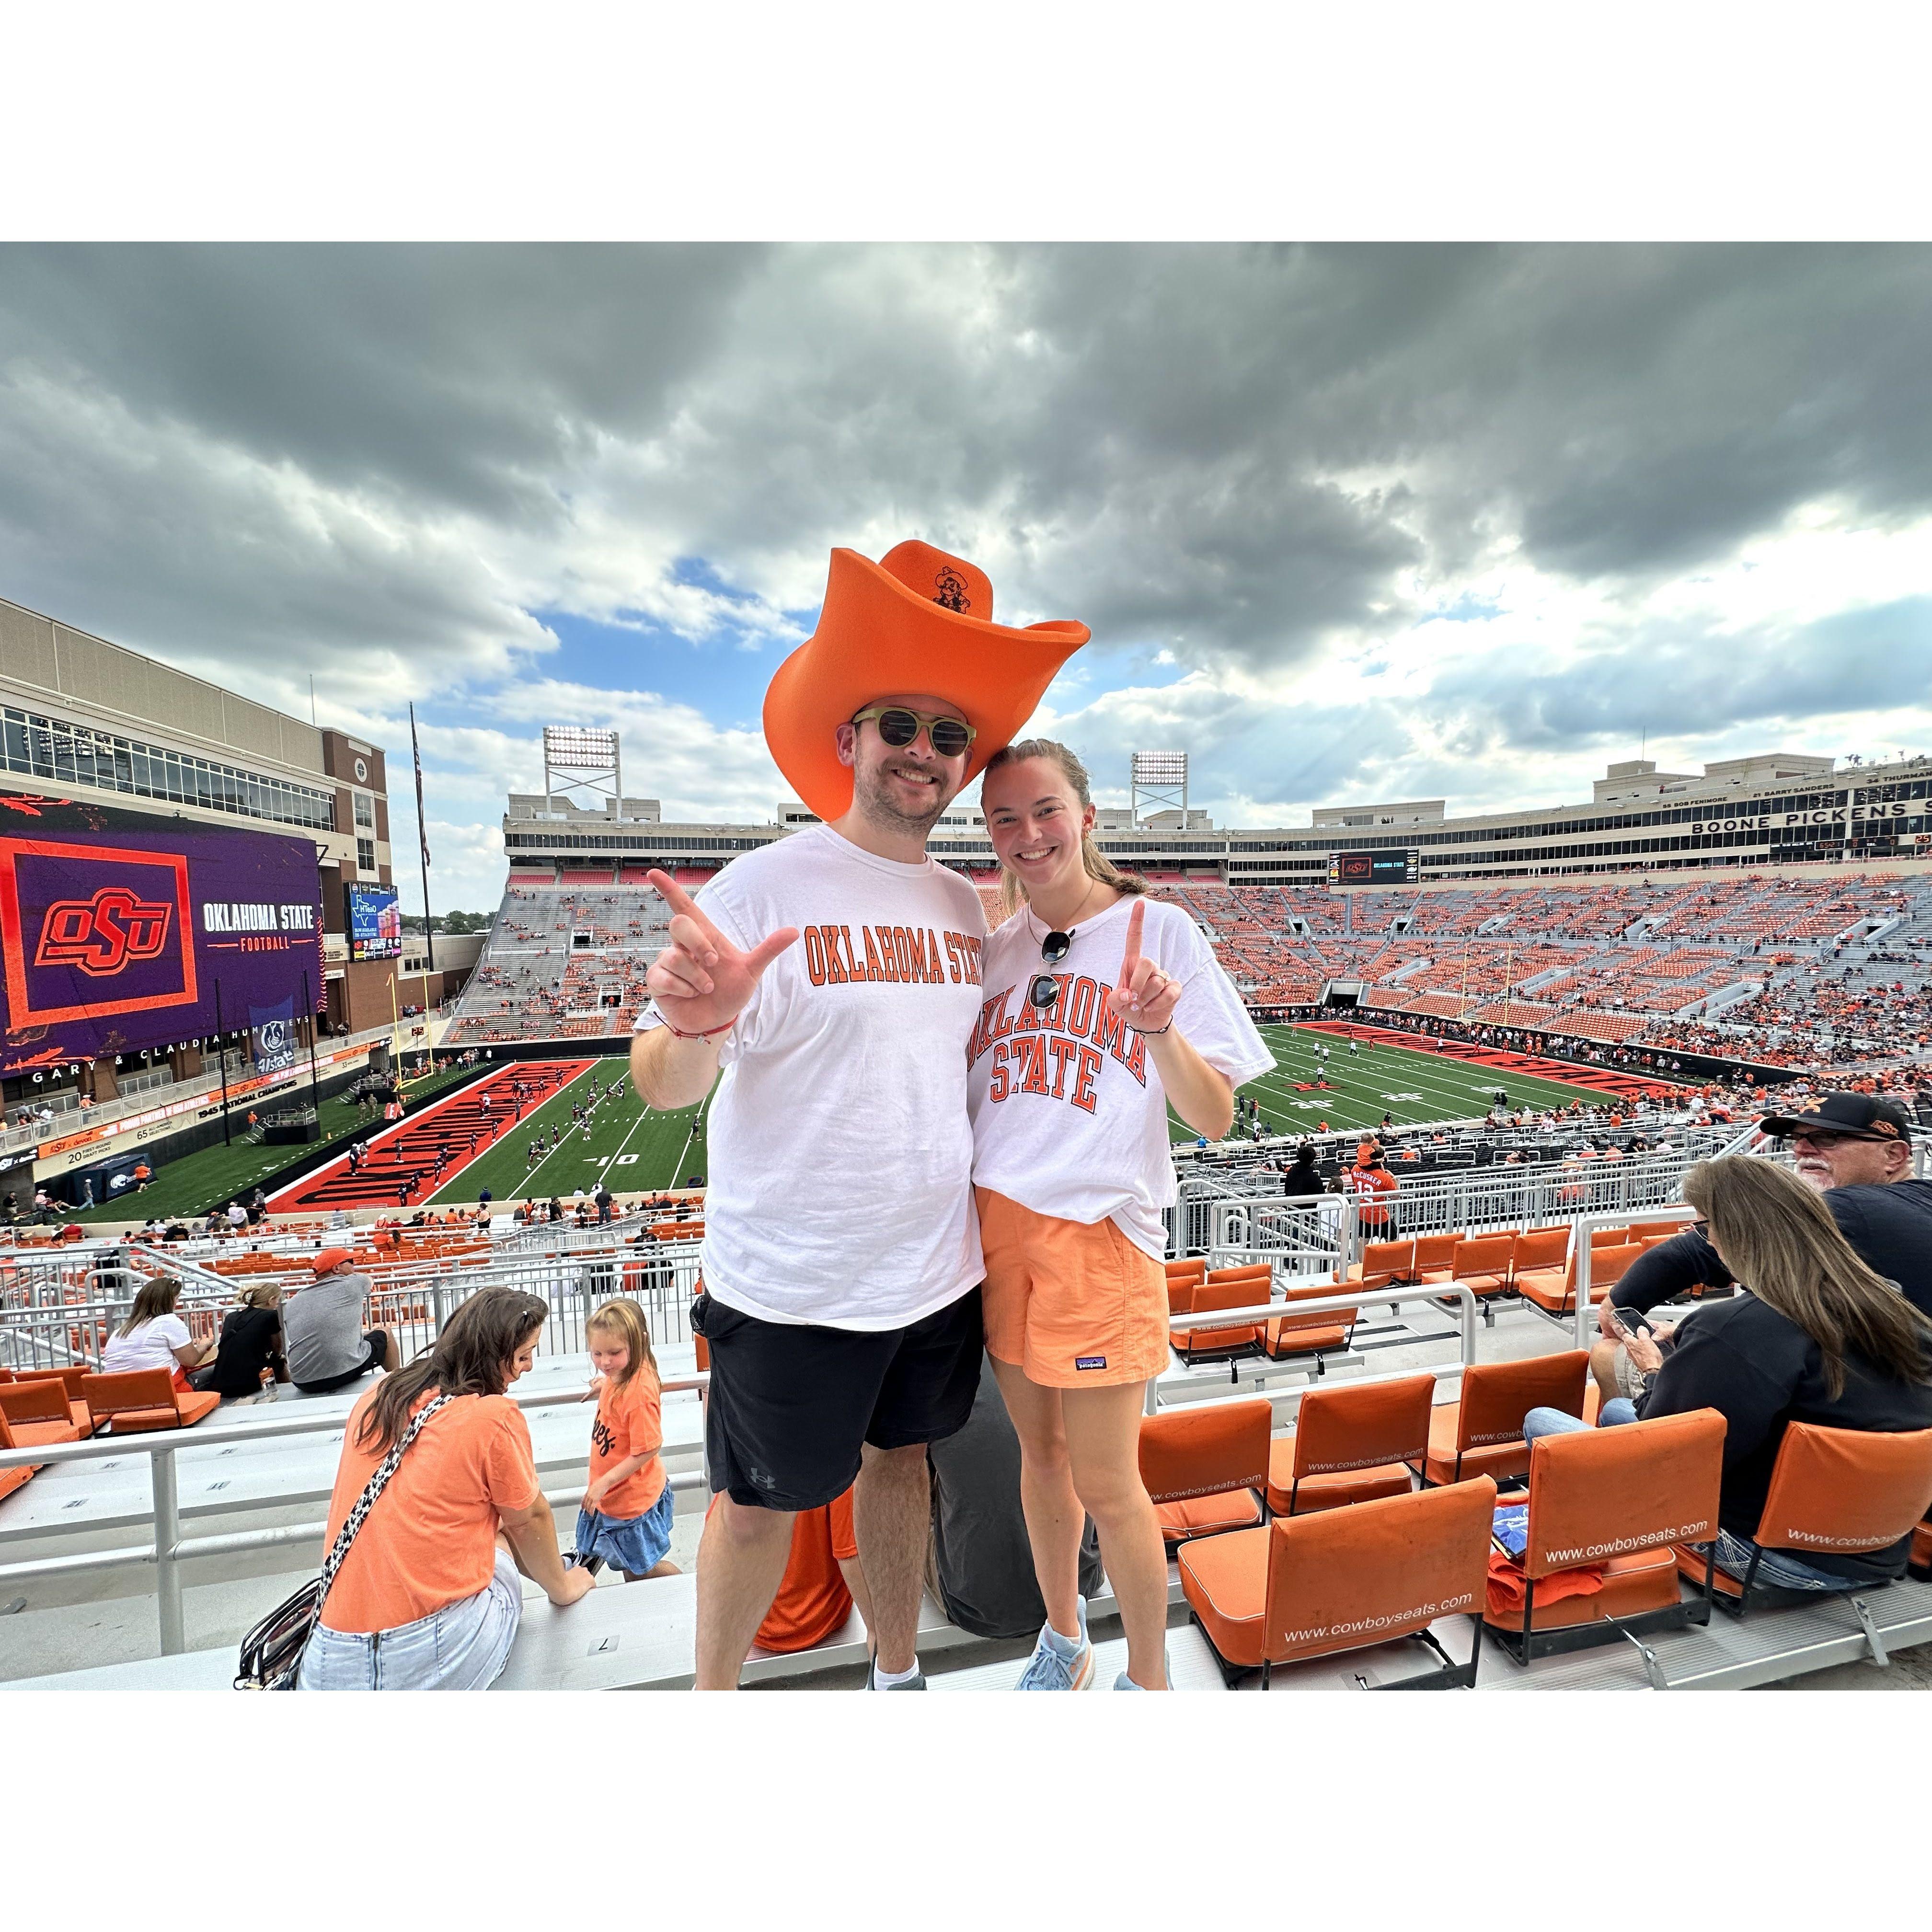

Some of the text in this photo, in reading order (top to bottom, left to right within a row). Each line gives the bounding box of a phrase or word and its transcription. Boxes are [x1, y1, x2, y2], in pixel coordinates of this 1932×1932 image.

[1794, 783, 1835, 793] SANDERS
[1884, 771, 1932, 782] THURMAN
[1690, 797, 1728, 805] FENIMORE
[1692, 816, 1770, 834] BOONE
[1786, 804, 1906, 826] PICKENS
[204, 903, 314, 932] OKLAHOMA STATE
[34, 887, 172, 977] OSU
[241, 936, 290, 953] FOOTBALL
[804, 925, 944, 987] OKLAHOMA
[413, 1027, 424, 1036] 25
[33, 1015, 309, 1083] GARY & CLAUDIA HUMEYS
[990, 1035, 1103, 1115] STATE
[1491, 1059, 1672, 1092] STATE
[197, 1105, 219, 1119] 1945
[219, 1093, 258, 1112] NATIONAL
[257, 1079, 298, 1099] CHAMPIONS
[1289, 1100, 1334, 1109] 30
[1380, 1092, 1424, 1102] 20
[73, 1137, 92, 1146] devon
[137, 1129, 148, 1140] 65
[69, 1151, 82, 1164] 20
[82, 1141, 112, 1154] FIRST-ROUND
[83, 1151, 97, 1159] DRAFT
[596, 1154, 640, 1167] 10
[1353, 1171, 1382, 1186] McCUSKER
[1308, 1447, 1424, 1471] www.cowboyseats.com
[1150, 1473, 1262, 1500] w.cowboyseats.com
[1546, 1519, 1708, 1564] www.cowboyseats.com
[1284, 1591, 1473, 1643] www.cowboyseats.com
